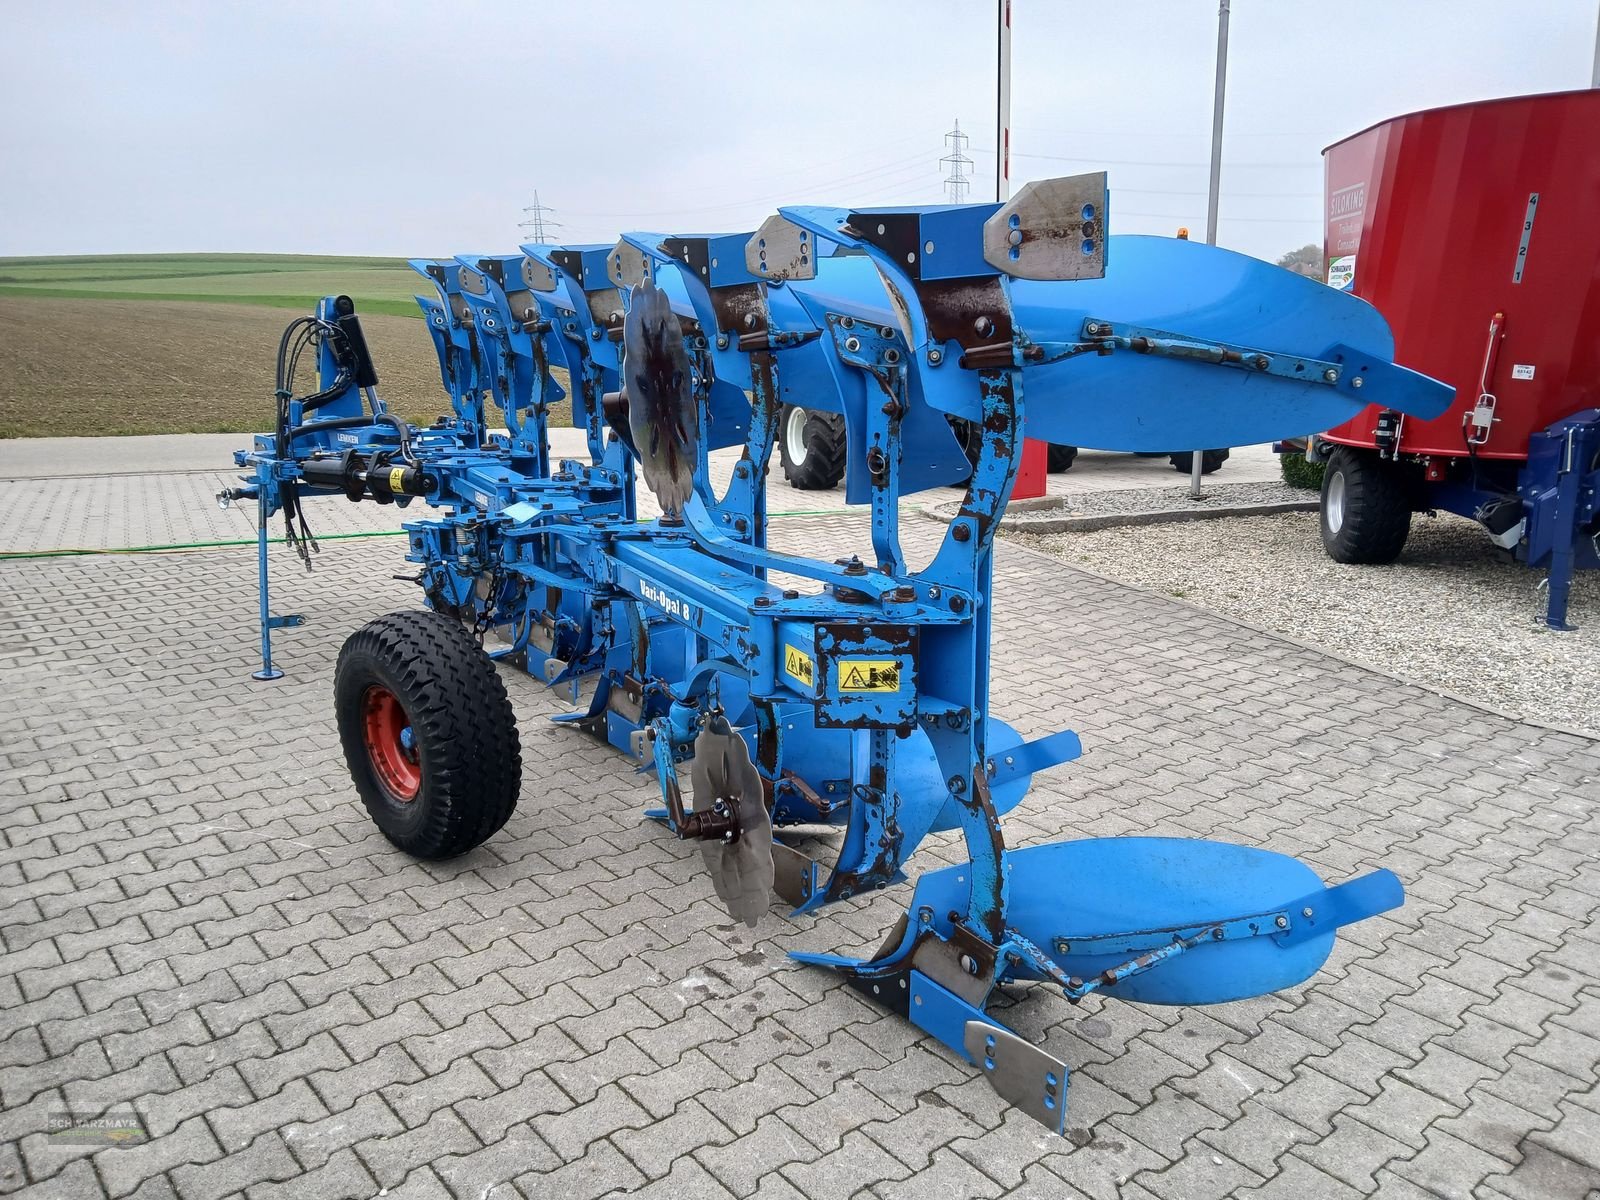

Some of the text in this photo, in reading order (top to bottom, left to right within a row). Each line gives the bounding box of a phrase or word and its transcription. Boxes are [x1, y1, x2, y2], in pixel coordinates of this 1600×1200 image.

[1331, 189, 1364, 216] SILOKING
[1529, 195, 1537, 206] 4
[1524, 221, 1531, 231] 3
[1519, 246, 1526, 256] 2
[1515, 271, 1520, 281] 1
[337, 433, 359, 445] LEMKEN
[639, 578, 690, 621] Vari-Opal 8
